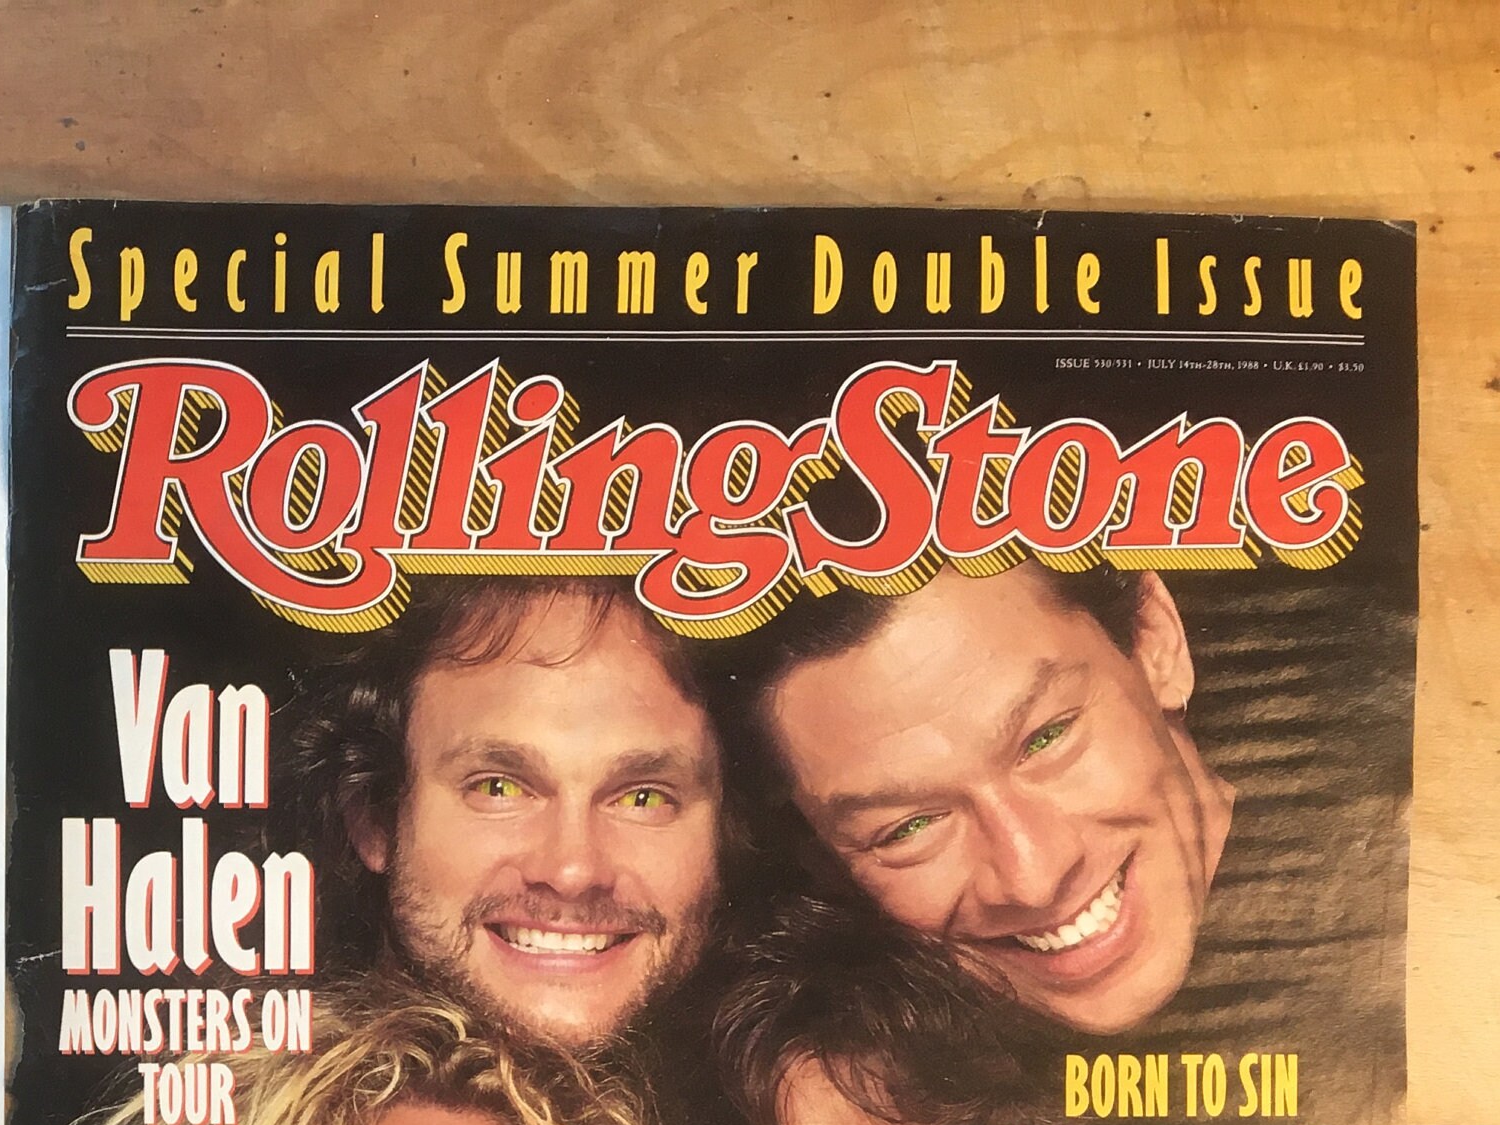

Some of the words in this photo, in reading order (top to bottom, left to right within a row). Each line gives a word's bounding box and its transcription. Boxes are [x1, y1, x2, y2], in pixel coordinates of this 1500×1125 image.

[67, 227, 385, 322] Special
[442, 233, 758, 316] Summer
[812, 235, 1101, 316] Double
[1155, 238, 1363, 319] Issue
[1055, 358, 1090, 368] ISSUE
[1148, 359, 1176, 369] JULY
[1237, 360, 1259, 370] 1988
[67, 357, 842, 640] Rolling
[784, 358, 1366, 598] Stone
[109, 648, 269, 809] Van
[61, 817, 315, 977] Halen
[58, 988, 253, 1055] MONSTERS
[261, 988, 313, 1055] ON
[1065, 1054, 1169, 1118] BORN
[1181, 1054, 1227, 1118] TO
[1239, 1054, 1299, 1118] SIN
